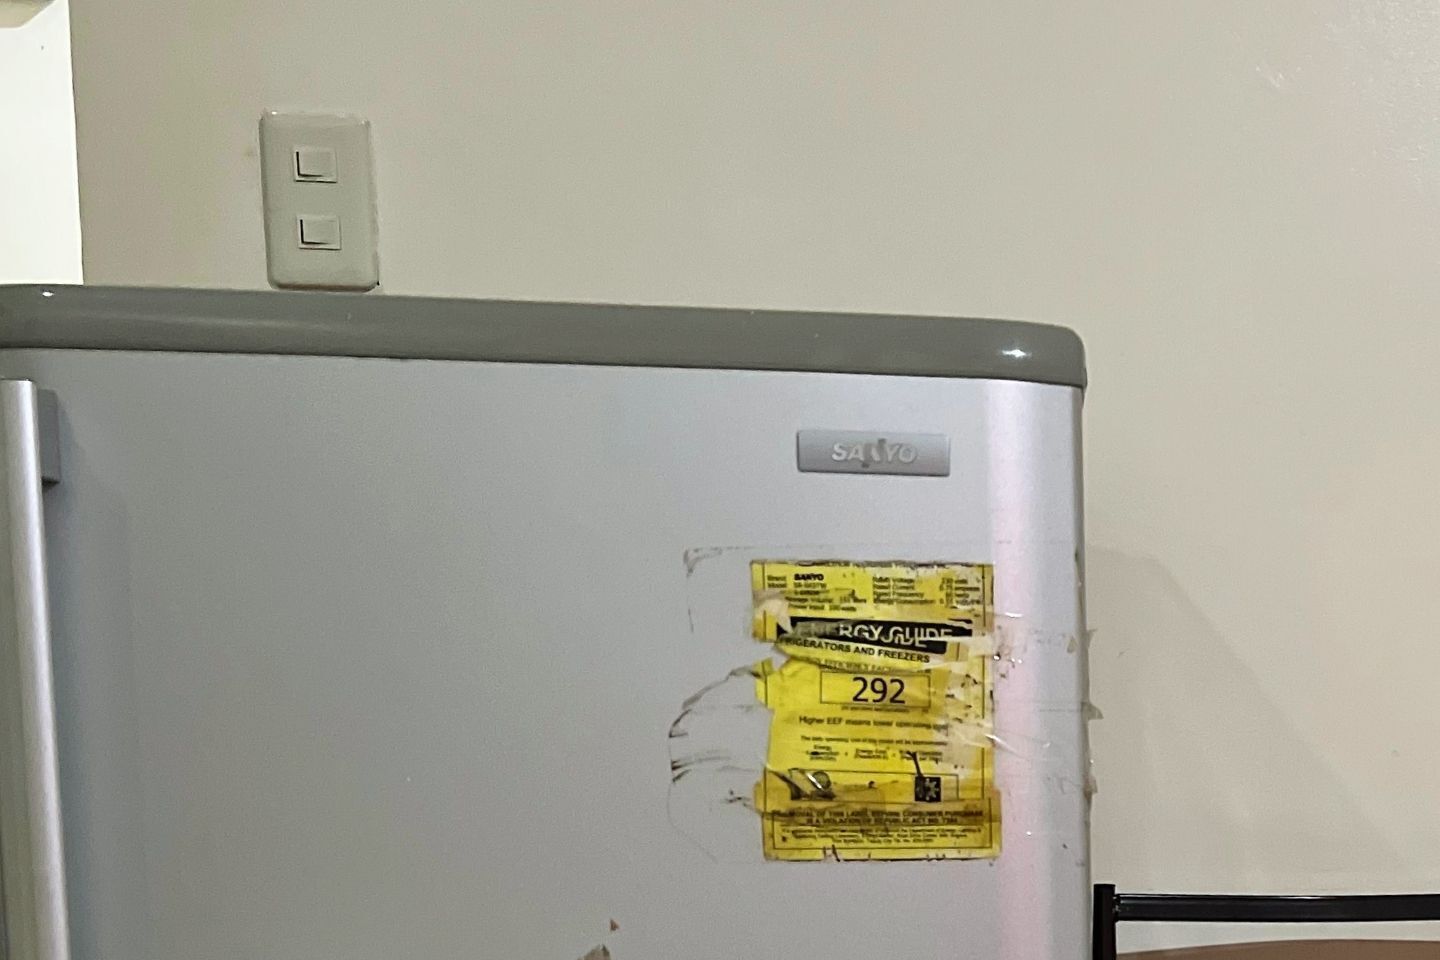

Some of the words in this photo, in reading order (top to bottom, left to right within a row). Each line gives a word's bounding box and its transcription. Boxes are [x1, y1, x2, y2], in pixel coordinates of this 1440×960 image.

[794, 573, 824, 581] SANYO
[853, 646, 876, 656] AND
[878, 648, 931, 664] FREEZERS
[852, 676, 906, 705] 292
[799, 716, 825, 725] Higher
